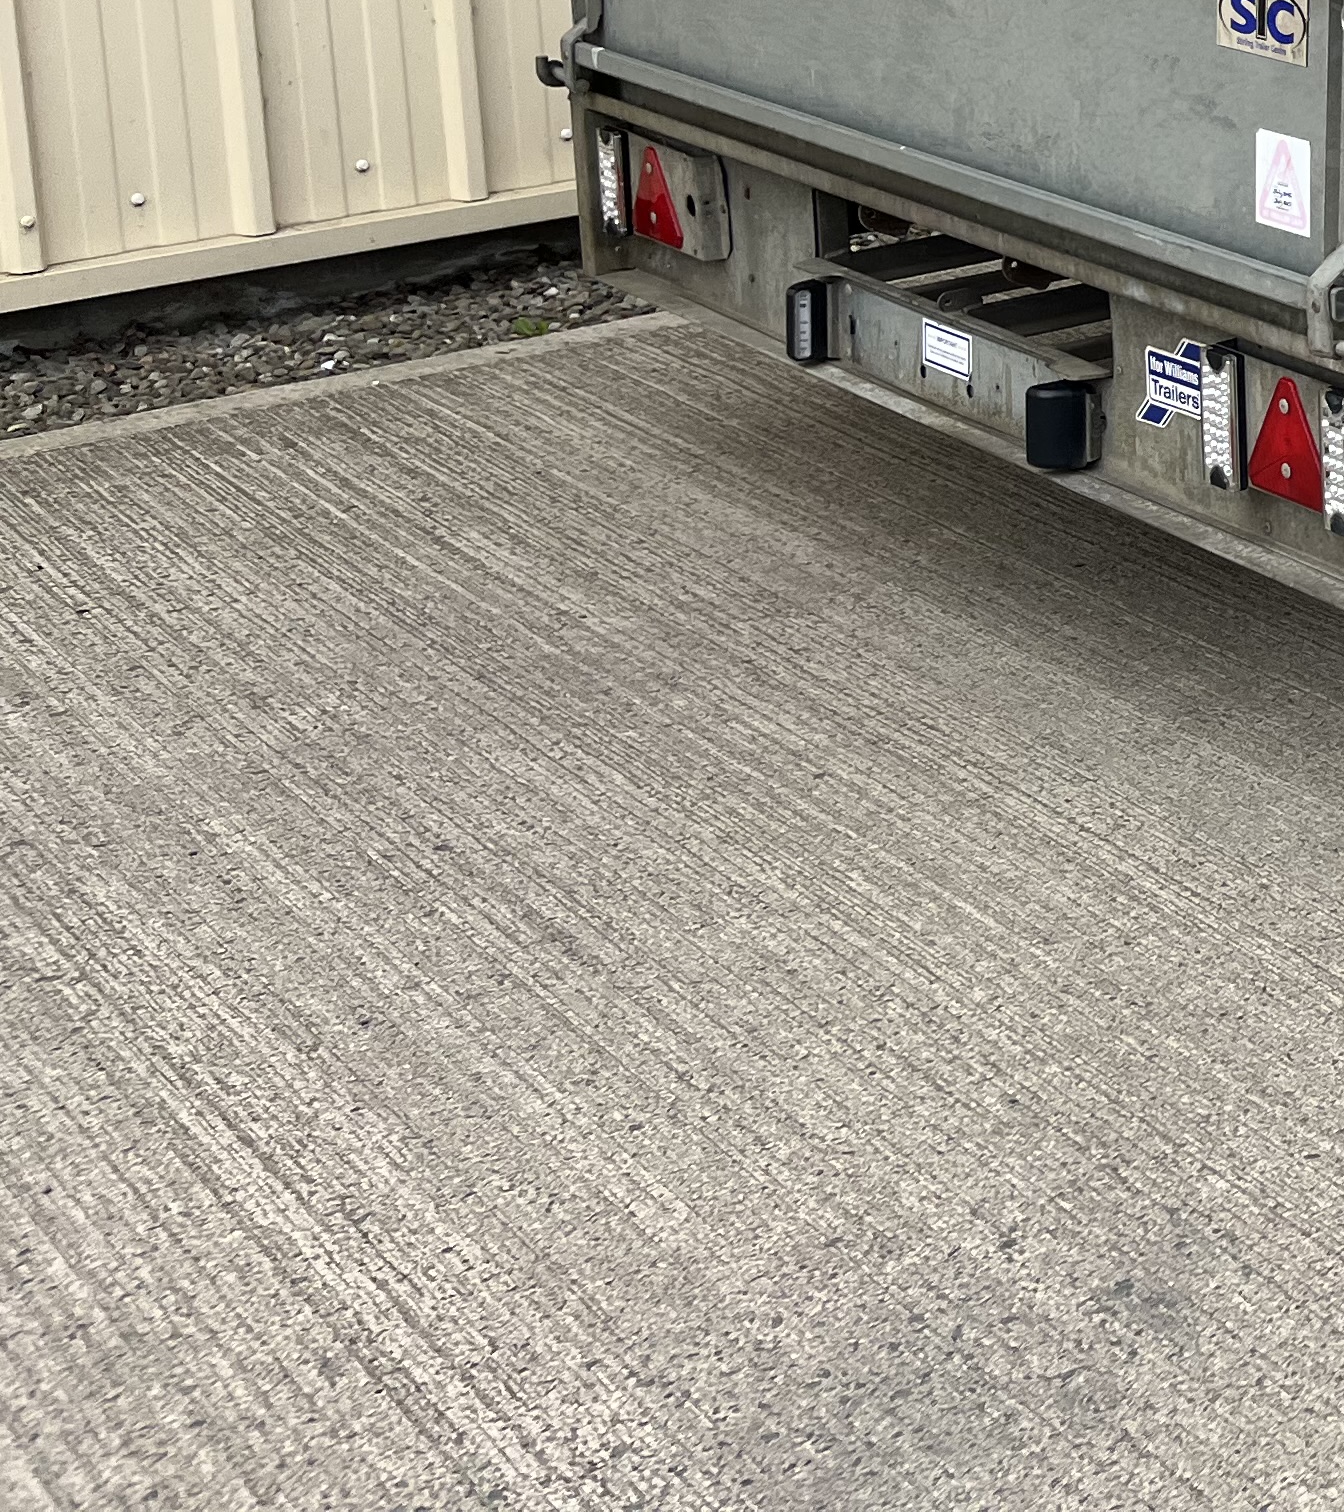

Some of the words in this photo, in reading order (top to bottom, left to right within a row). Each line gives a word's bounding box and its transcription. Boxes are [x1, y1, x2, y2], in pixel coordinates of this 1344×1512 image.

[1149, 355, 1164, 374] Ifor
[1163, 359, 1199, 386] Williams
[1151, 377, 1200, 410] Trailers
